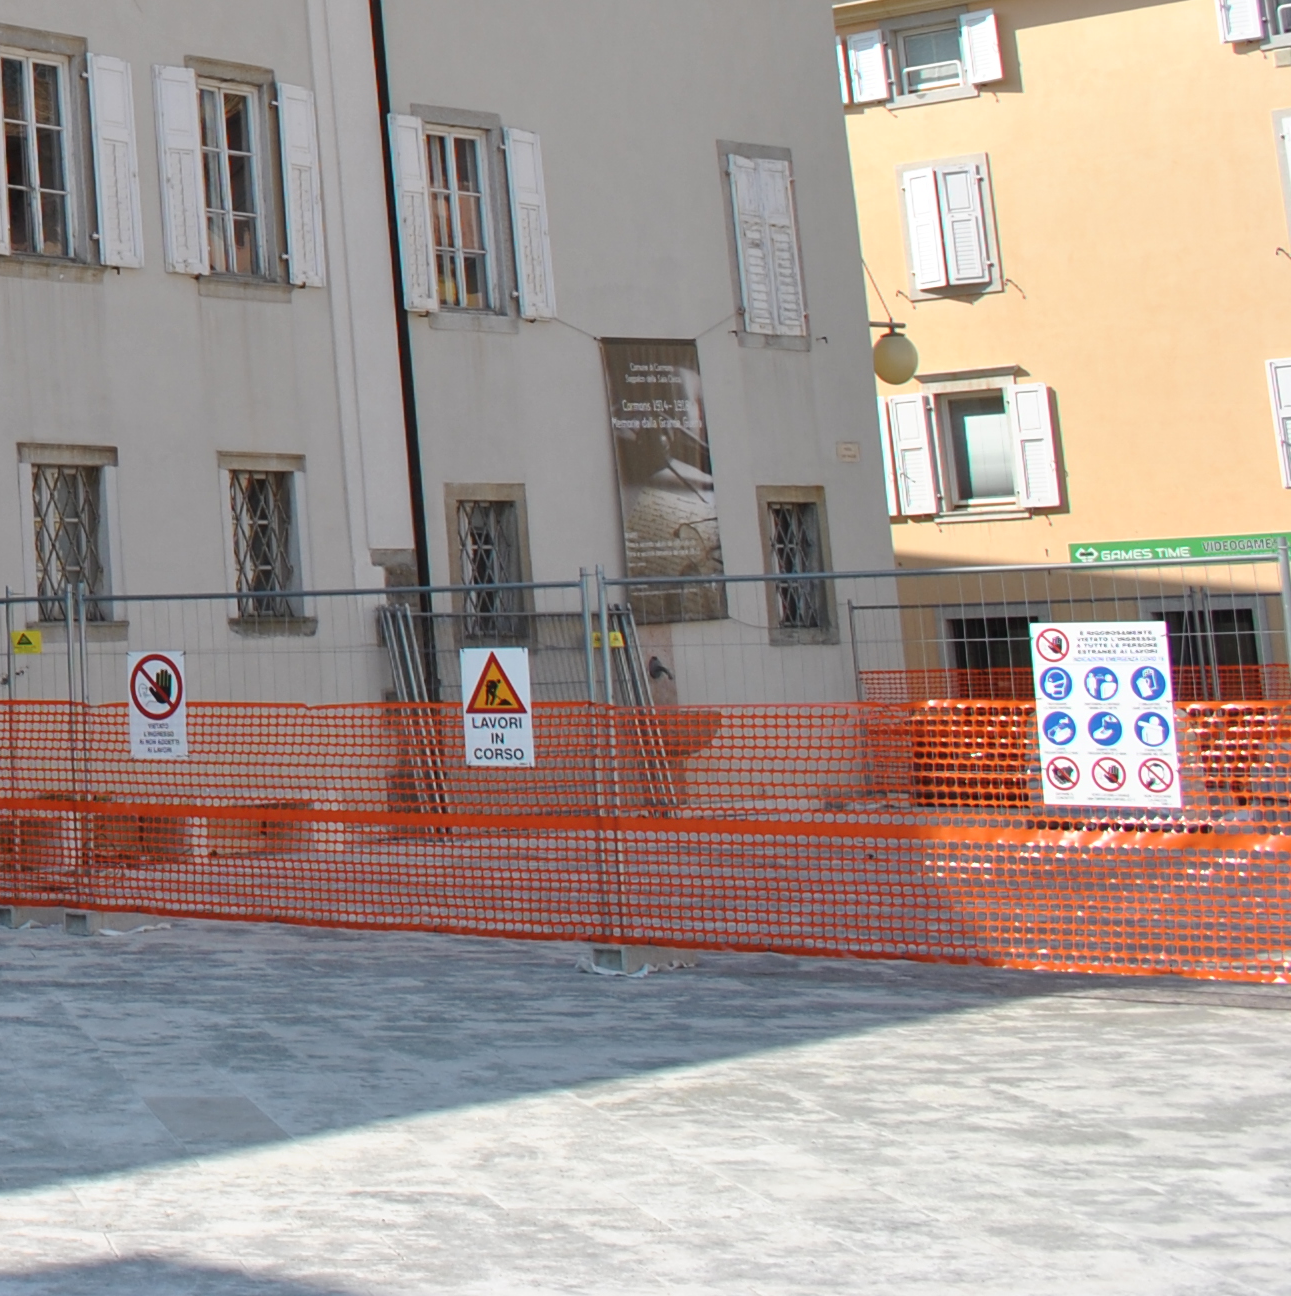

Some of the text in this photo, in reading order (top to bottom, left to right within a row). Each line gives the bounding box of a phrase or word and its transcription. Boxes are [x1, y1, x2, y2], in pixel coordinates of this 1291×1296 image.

[622, 399, 651, 412] Cormons
[1101, 548, 1153, 561] GAMES
[1155, 546, 1191, 558] TIME
[472, 717, 522, 728] LAVORI
[491, 733, 504, 743] IN
[474, 748, 524, 759] CORSO
